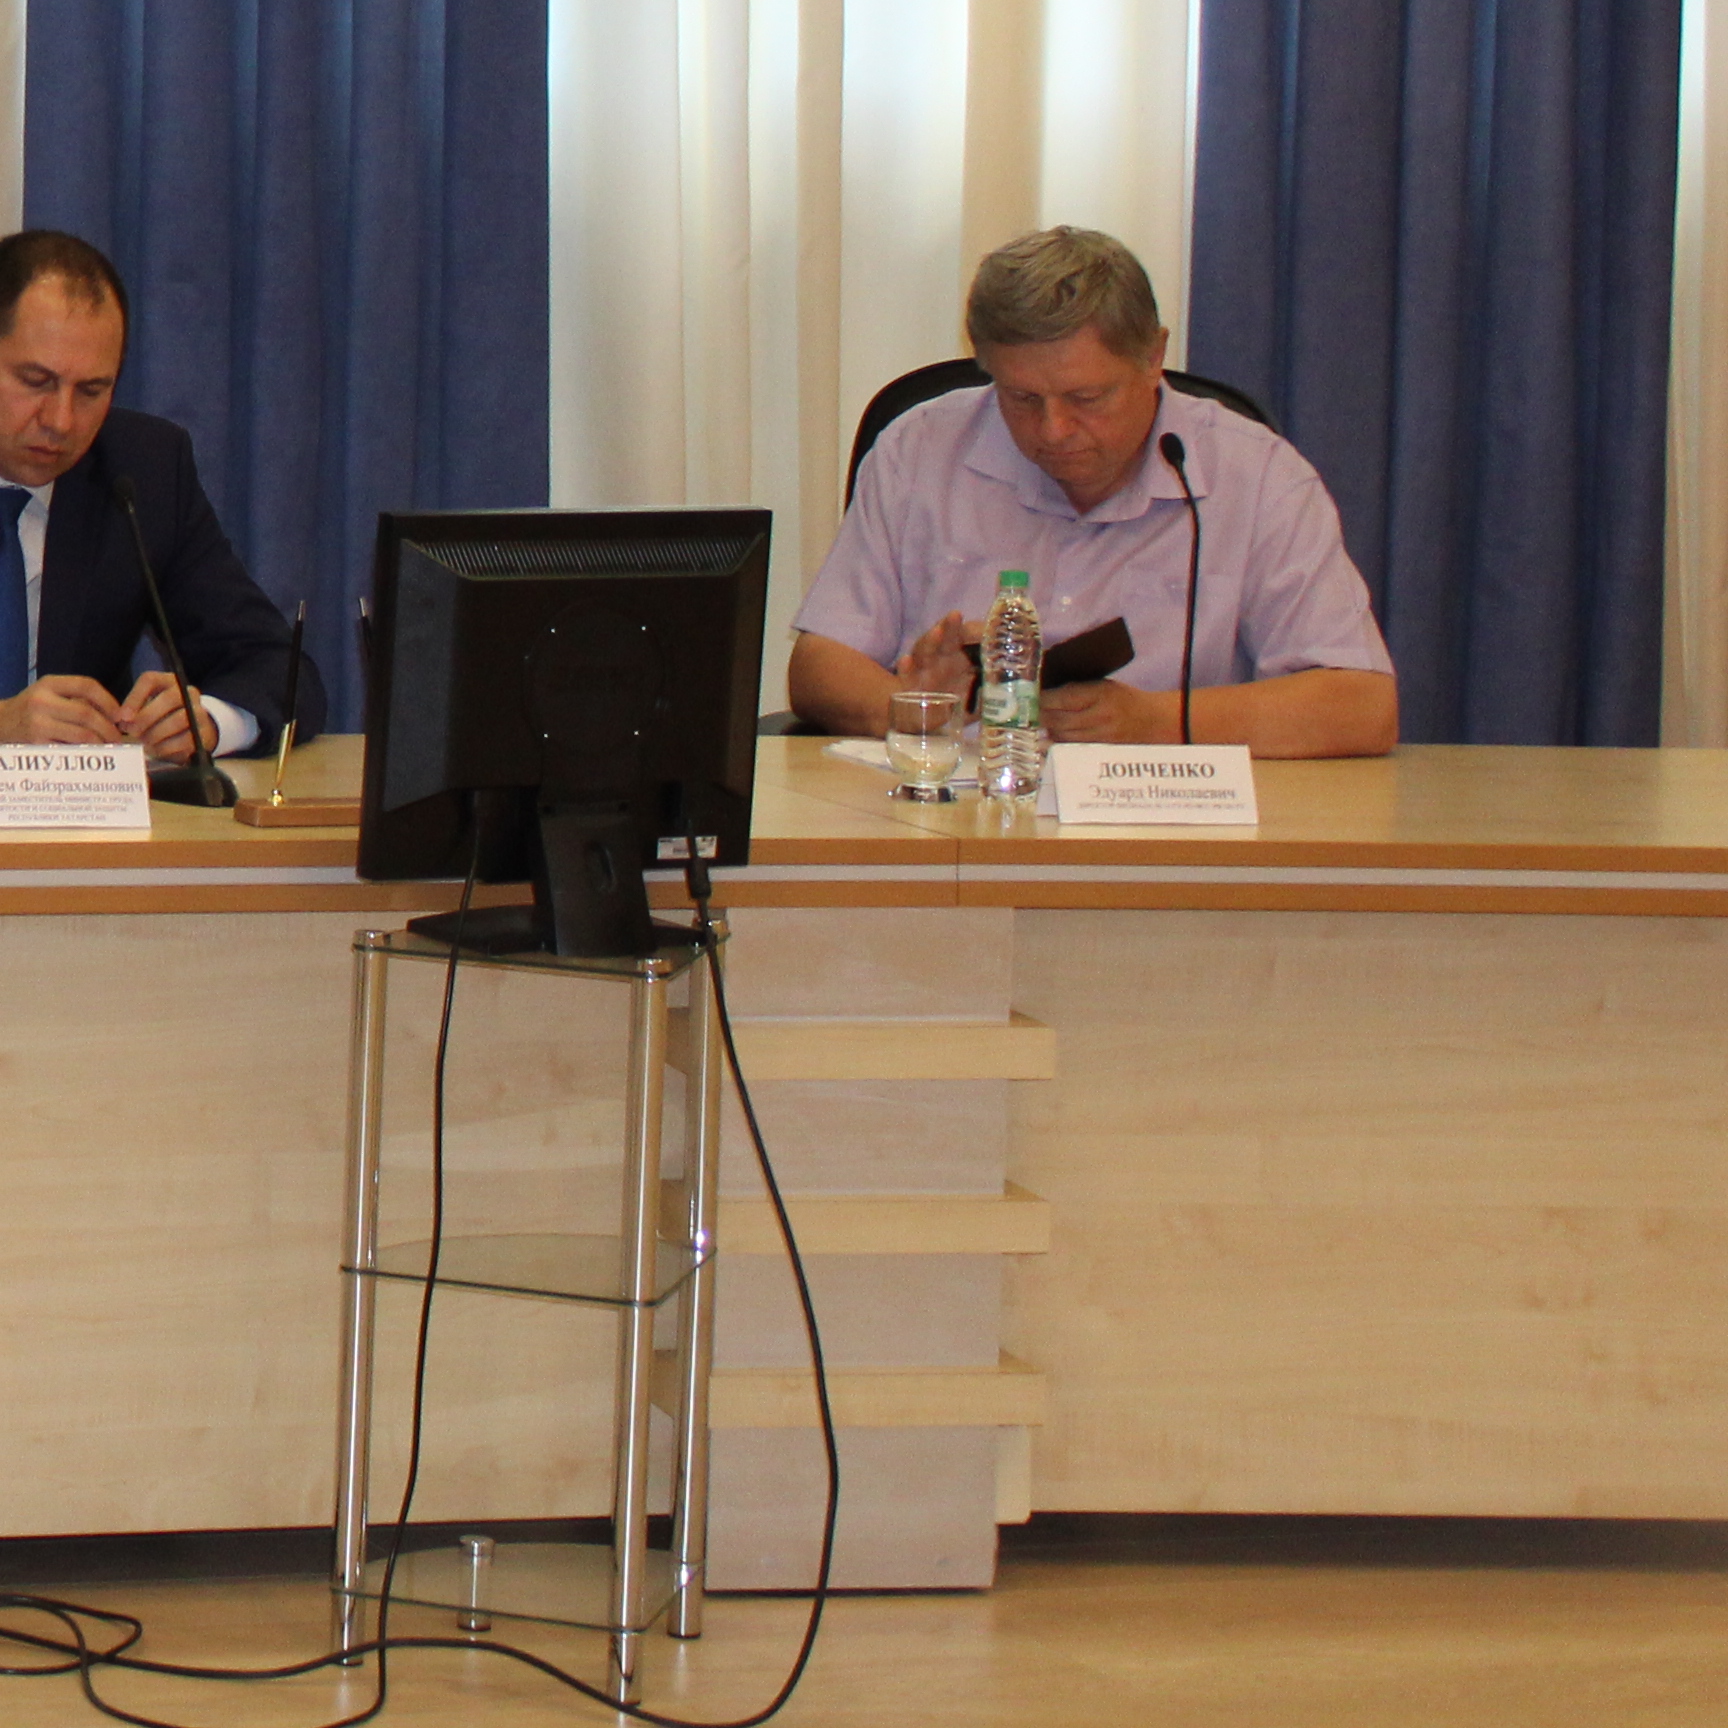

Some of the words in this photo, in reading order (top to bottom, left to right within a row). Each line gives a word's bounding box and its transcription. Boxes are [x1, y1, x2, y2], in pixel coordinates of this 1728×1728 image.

[1098, 762, 1215, 779] ДОНЧЕНКО
[20, 778, 143, 795] Файзрахманович
[1148, 784, 1236, 800] Николаевич
